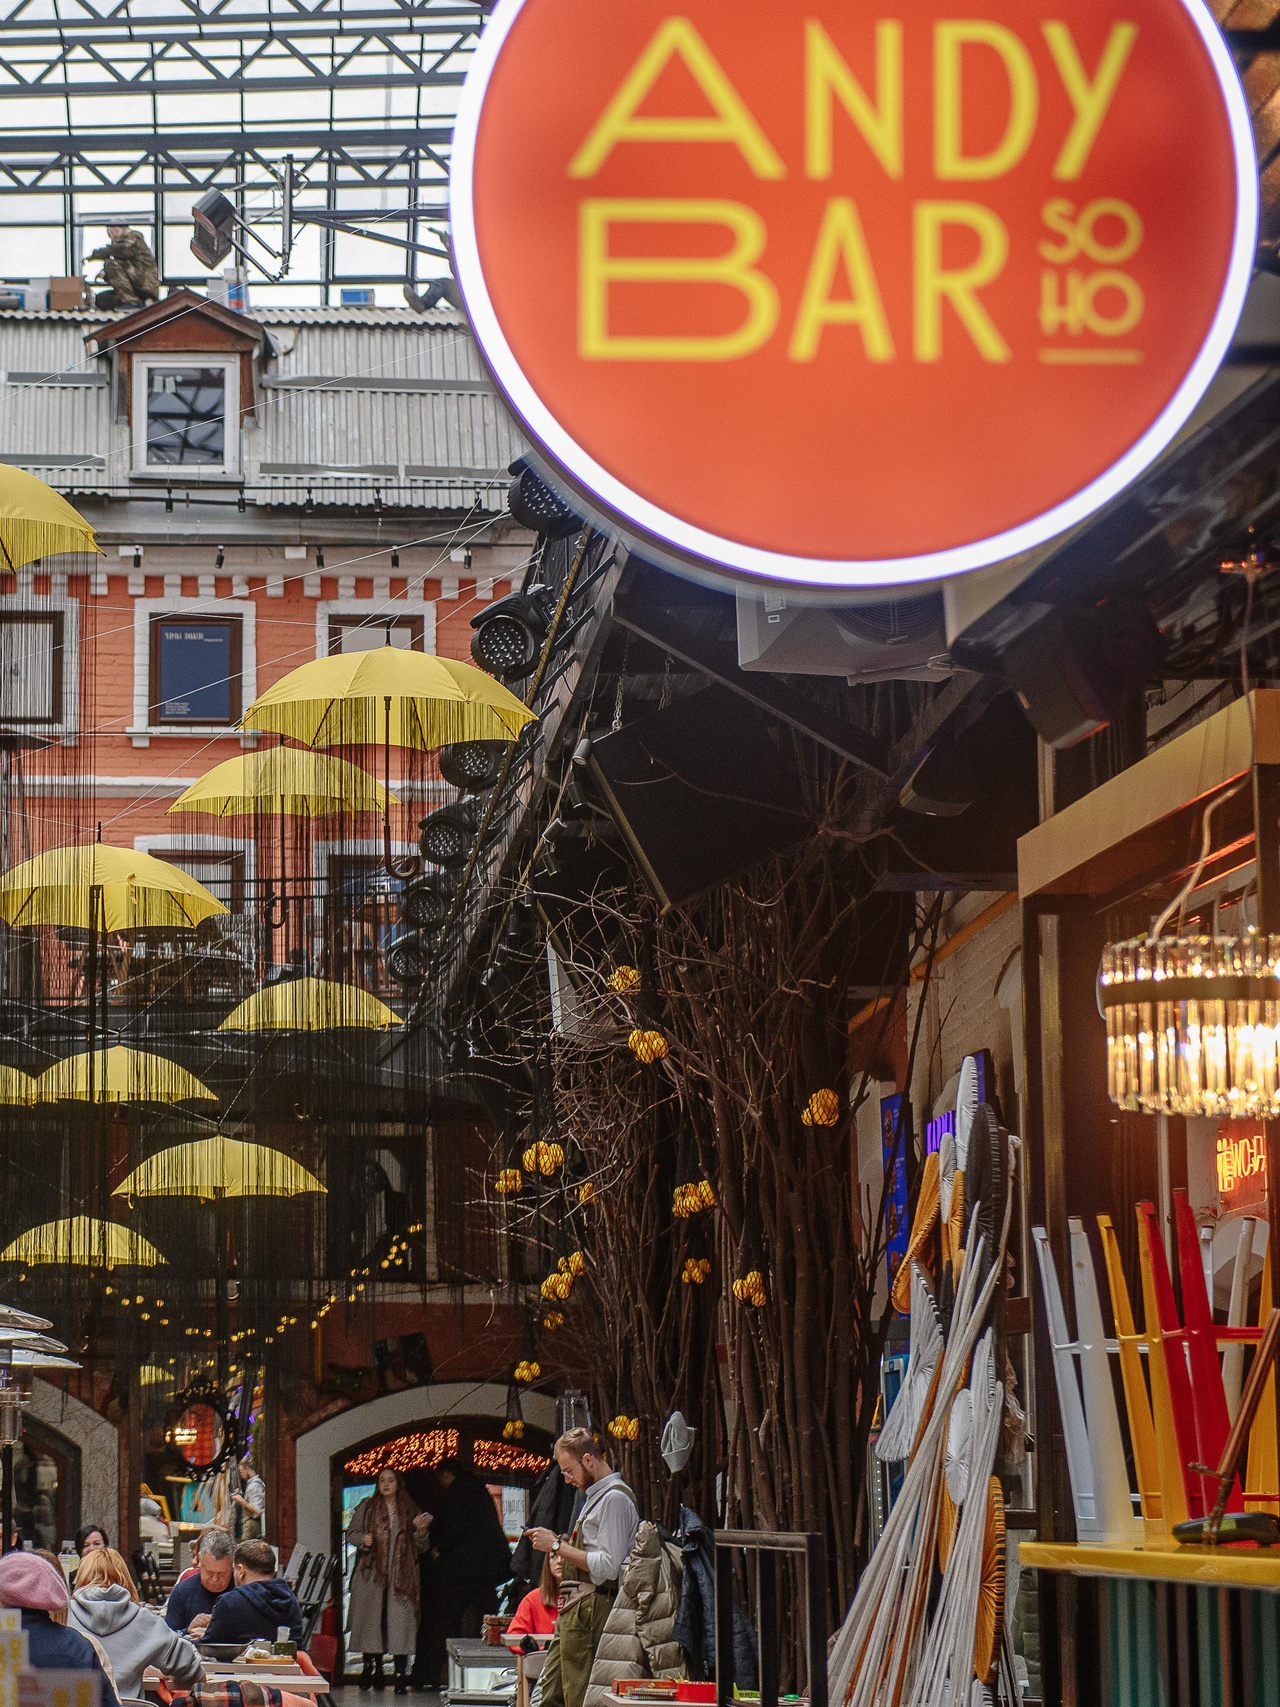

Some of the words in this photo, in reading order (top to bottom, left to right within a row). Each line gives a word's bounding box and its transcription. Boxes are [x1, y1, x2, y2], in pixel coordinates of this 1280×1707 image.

[566, 16, 1139, 181] ANDY
[577, 197, 1011, 363] BAR
[1038, 198, 1144, 264] SO
[1038, 270, 1144, 336] HO
